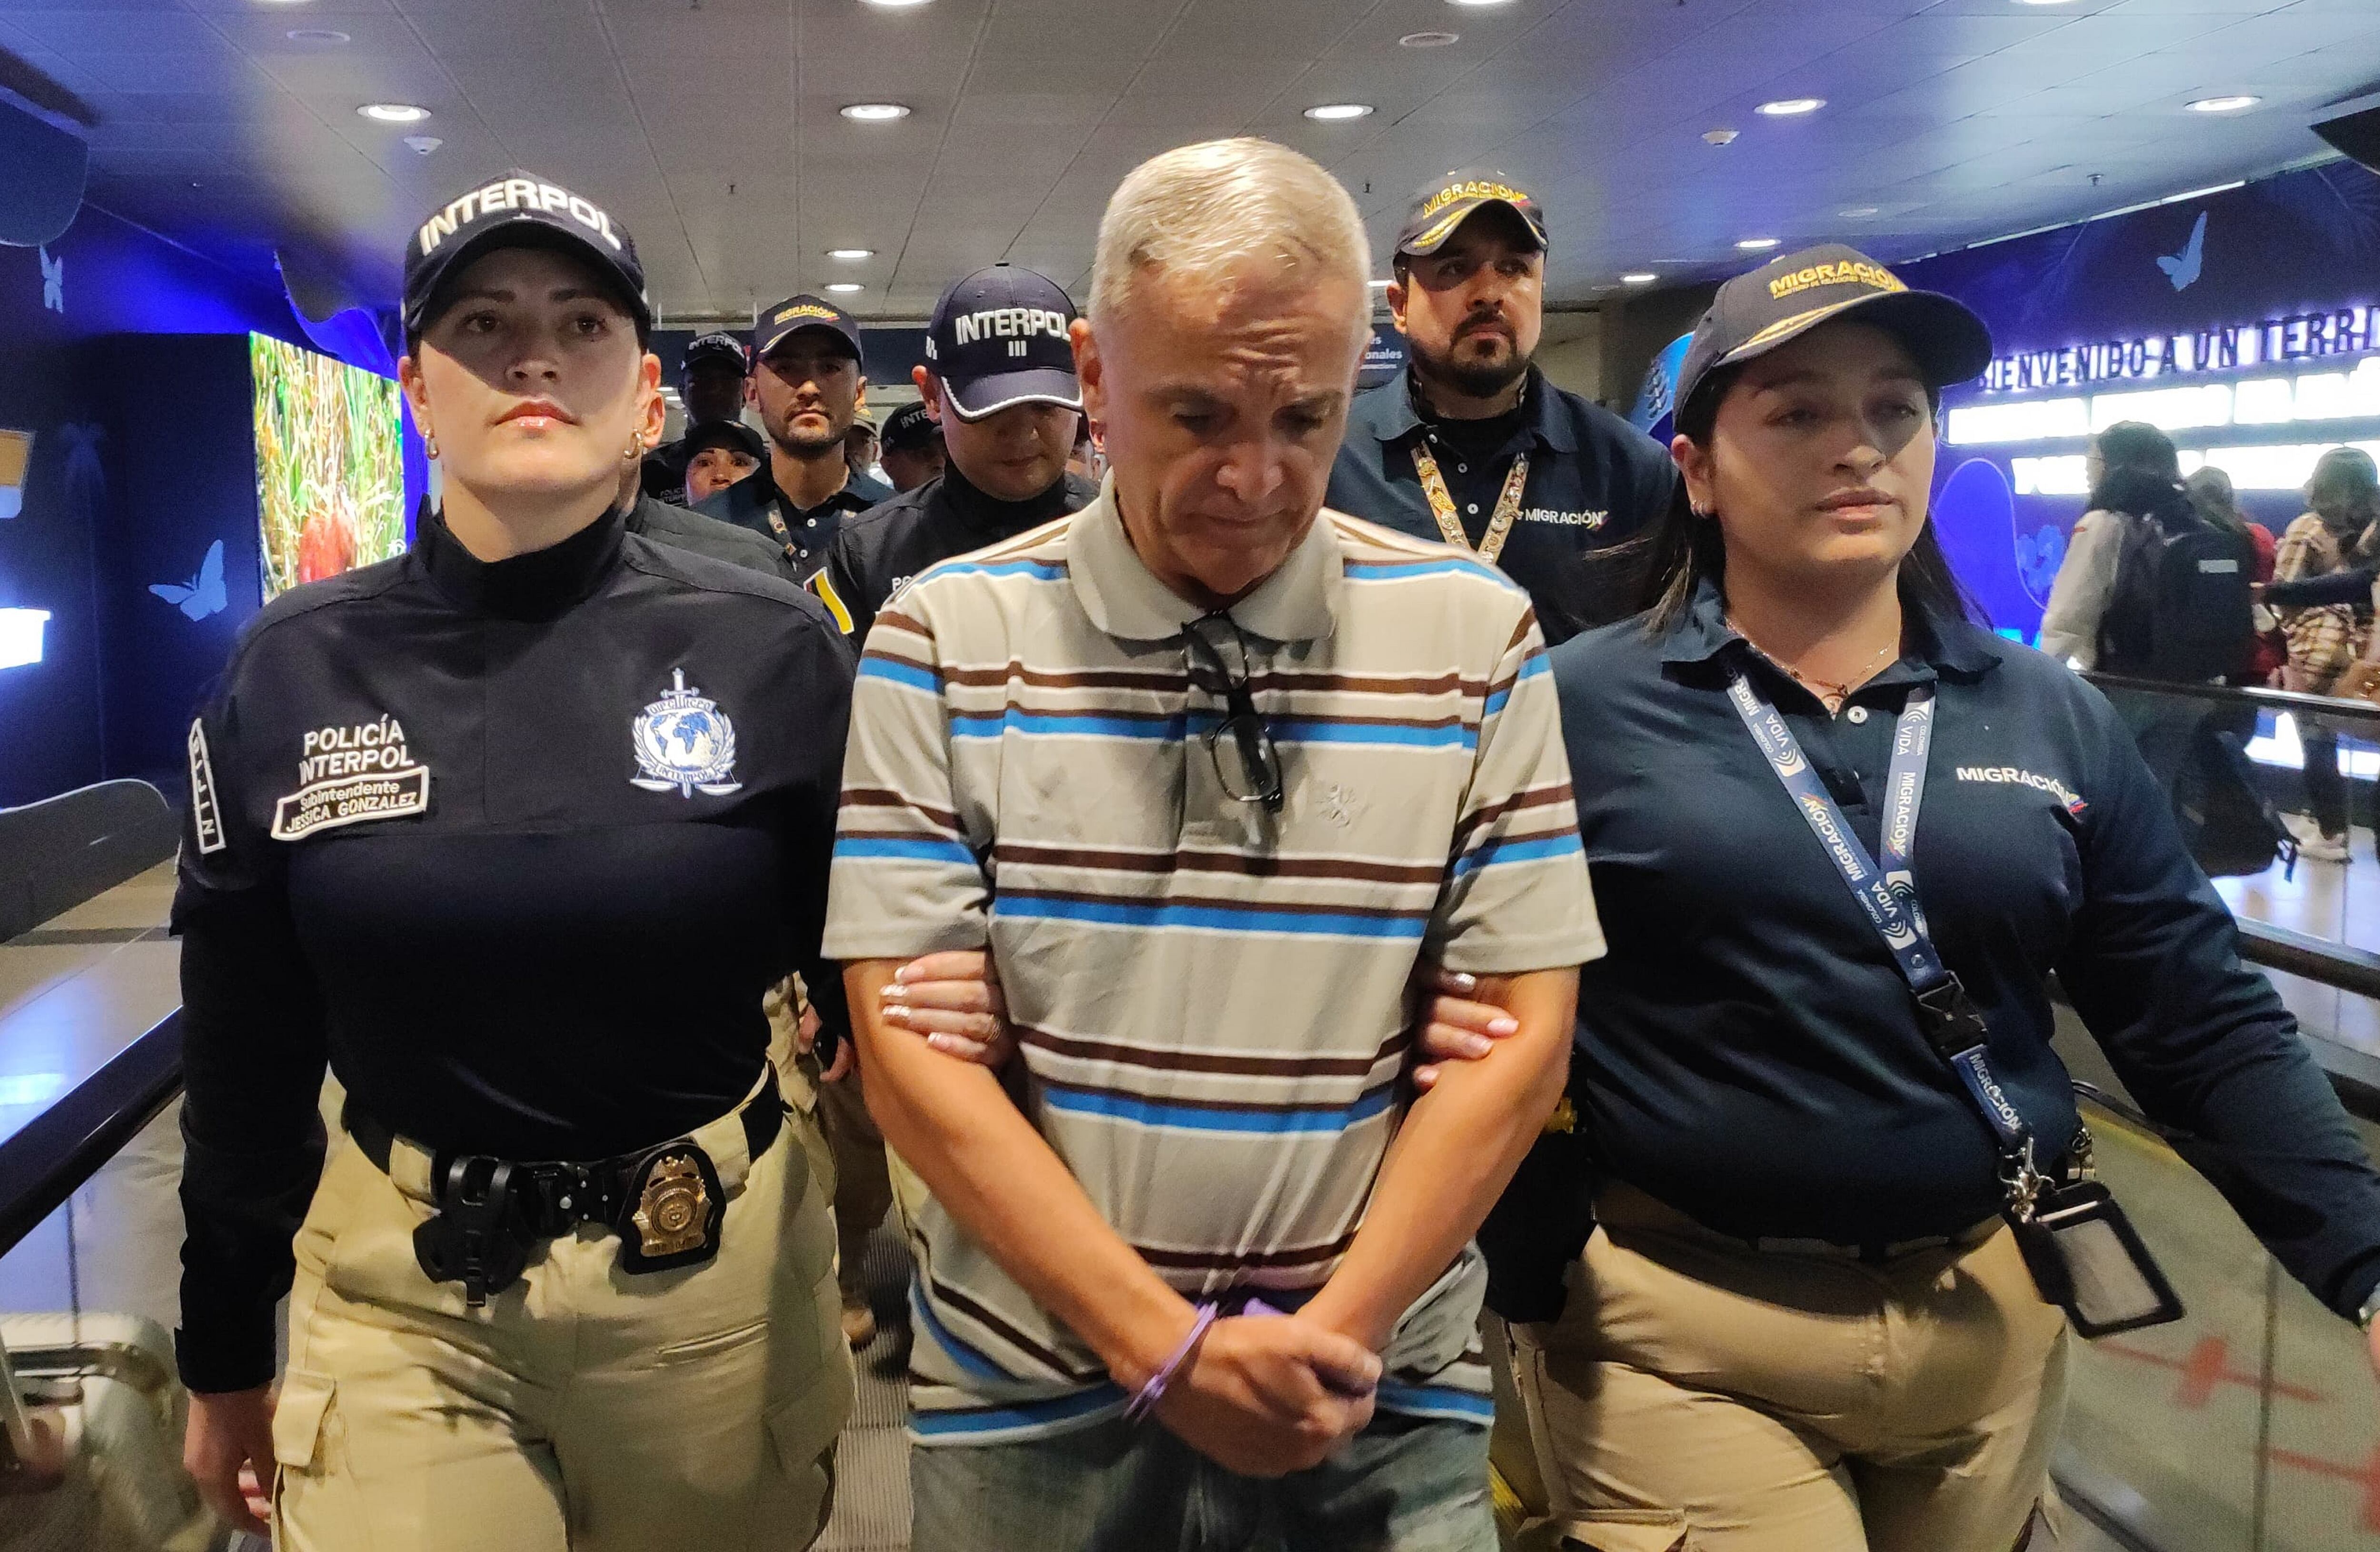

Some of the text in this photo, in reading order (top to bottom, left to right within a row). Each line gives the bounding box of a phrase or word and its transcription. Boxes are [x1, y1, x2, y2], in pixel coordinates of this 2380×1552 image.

[419, 179, 622, 256] INTERPOL
[688, 335, 745, 359] INTERPOL
[955, 308, 1071, 346] INTERPOL
[2159, 334, 2177, 374] A
[2195, 326, 2238, 370] UN
[1525, 508, 1603, 525] MIGRACIÓN
[304, 713, 405, 756] POLICÍA
[1765, 713, 1790, 748] VIDA
[1896, 726, 1914, 756] VIDA
[298, 744, 415, 786] INTERPOL
[300, 781, 399, 811] Subintendente
[1956, 767, 2072, 808] MIGRACIÓN
[286, 791, 417, 832] JESSICA GONZALEZ
[1894, 771, 1916, 856] MIGRACIÓN
[1803, 798, 1865, 881] MIGRACIÓN
[1870, 880, 1897, 918] VIDA
